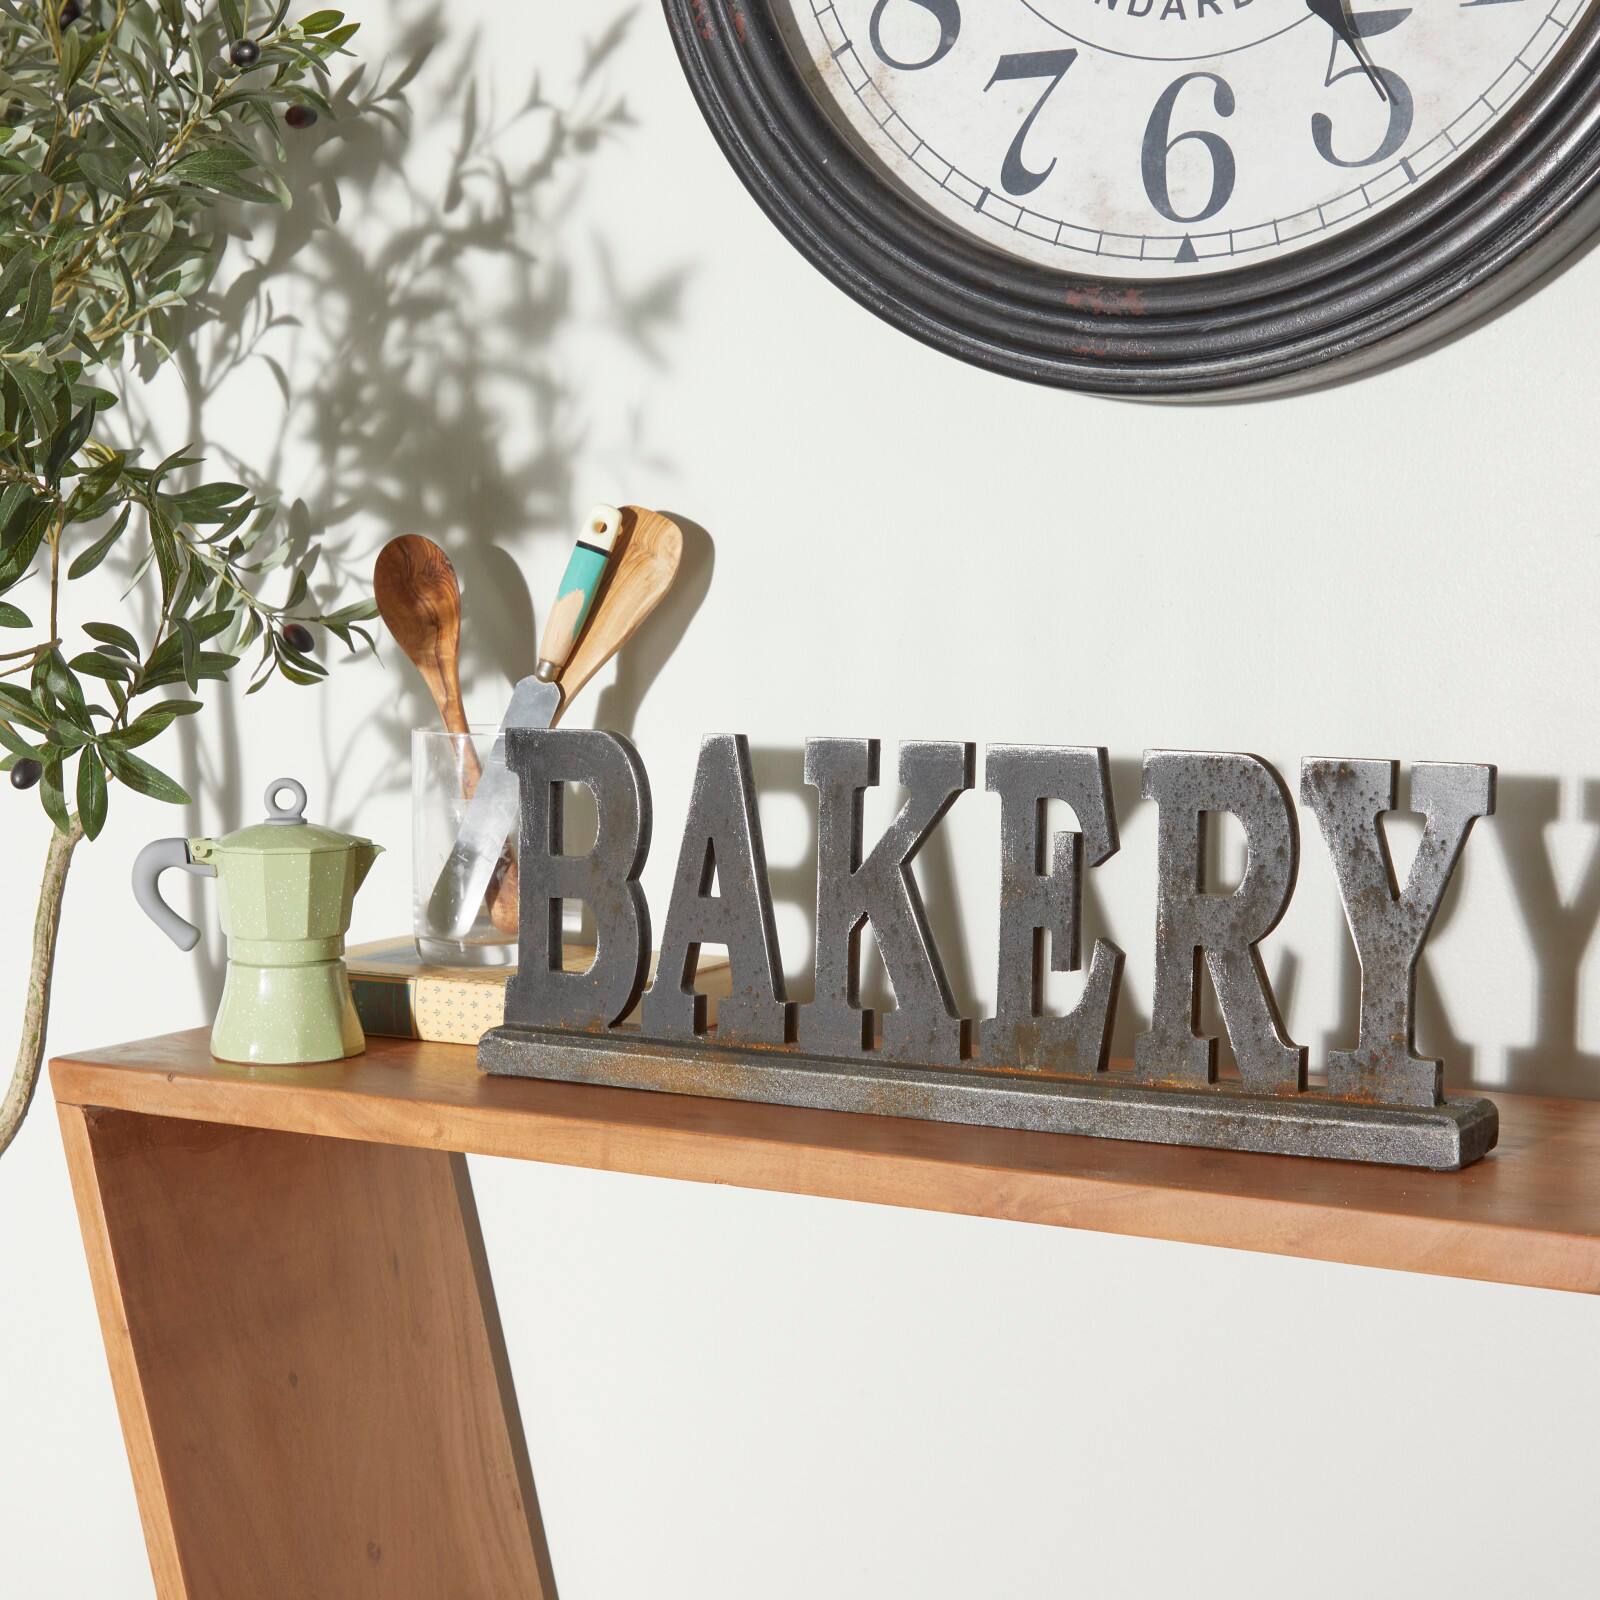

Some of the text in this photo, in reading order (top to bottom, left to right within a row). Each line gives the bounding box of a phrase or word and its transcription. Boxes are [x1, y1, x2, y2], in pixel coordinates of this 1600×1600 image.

[983, 48, 1078, 196] 7
[1141, 72, 1236, 221] 6
[1311, 7, 1414, 168] 5
[506, 728, 1497, 1106] BAKERY
